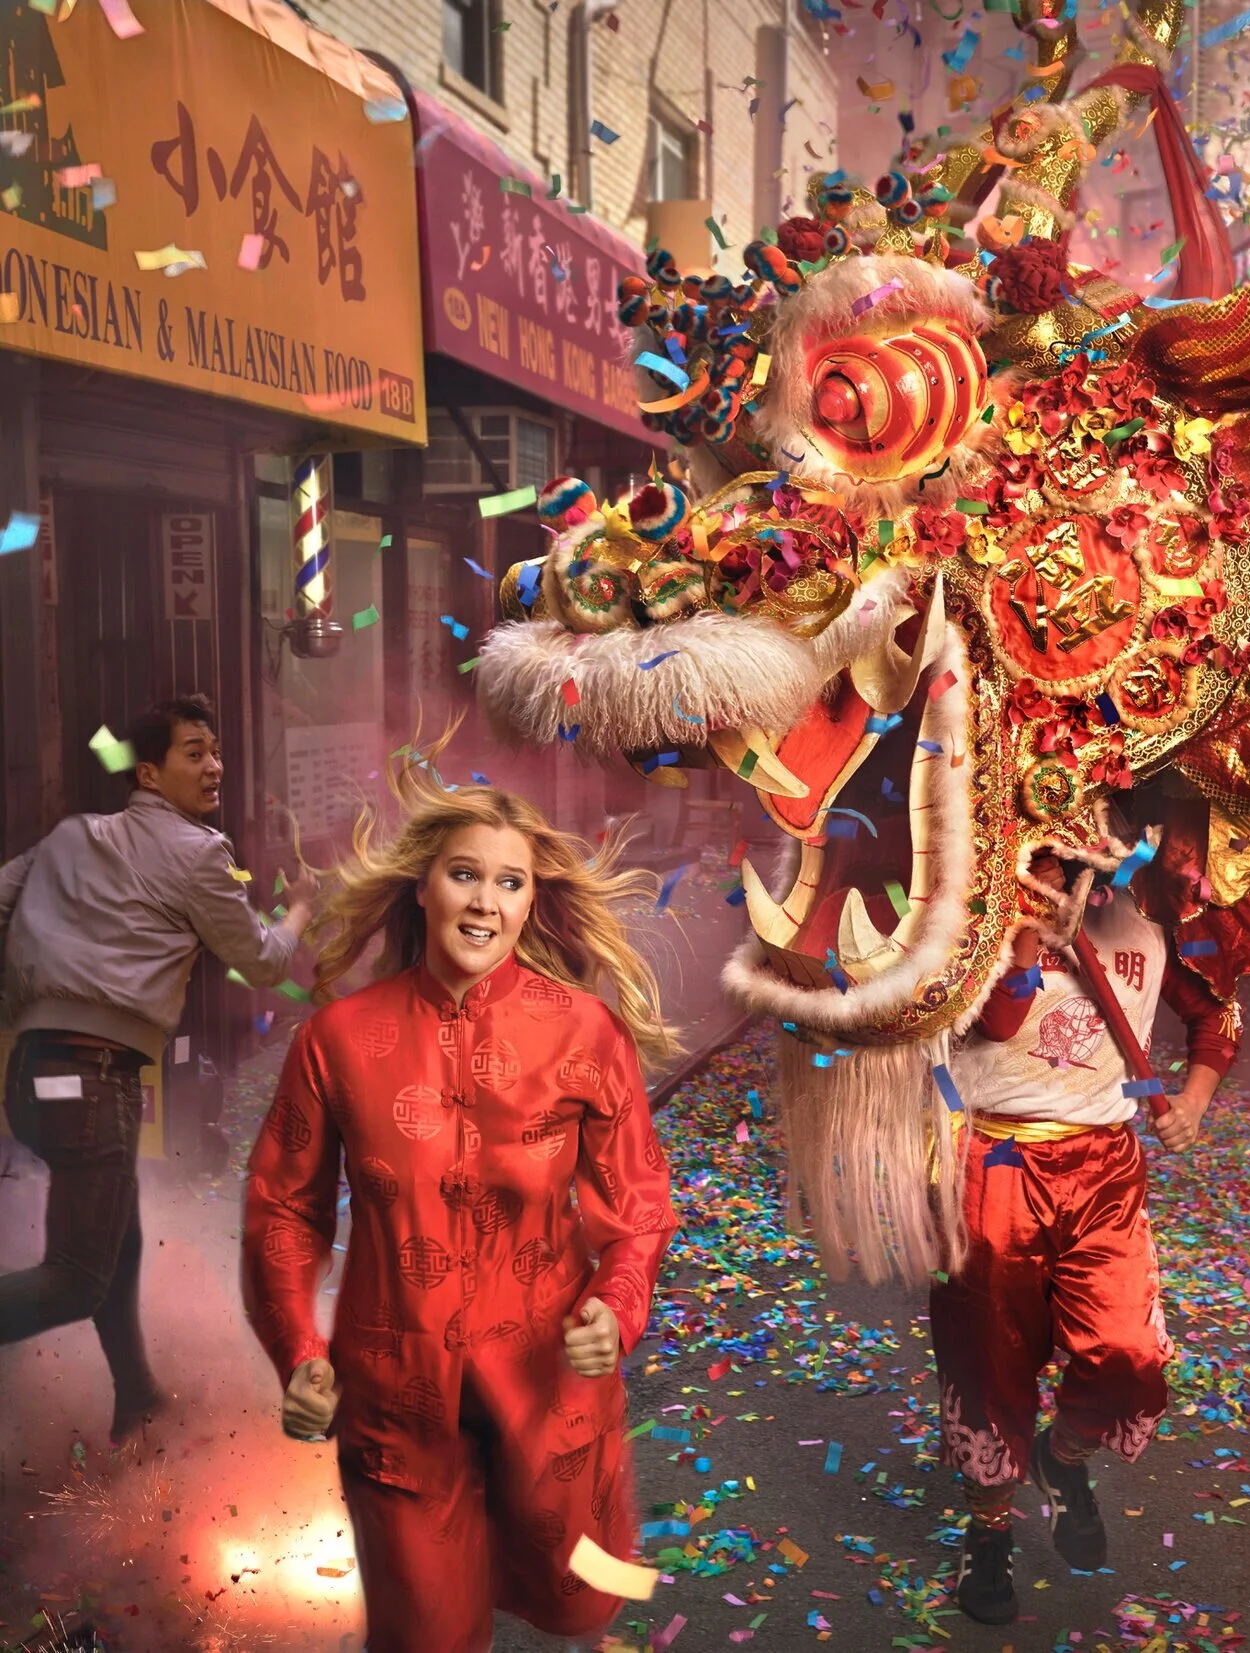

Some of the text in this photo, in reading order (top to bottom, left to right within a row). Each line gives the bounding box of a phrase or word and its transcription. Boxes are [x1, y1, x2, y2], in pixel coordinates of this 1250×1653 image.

[151, 100, 367, 302] 小食館
[0, 247, 372, 412] ONESIAN & MALAYSIAN FOOD
[476, 292, 510, 361] NEW
[518, 315, 557, 381] HONG
[562, 339, 597, 400] KONG
[382, 377, 413, 416] 18B
[170, 517, 205, 585] OPEN
